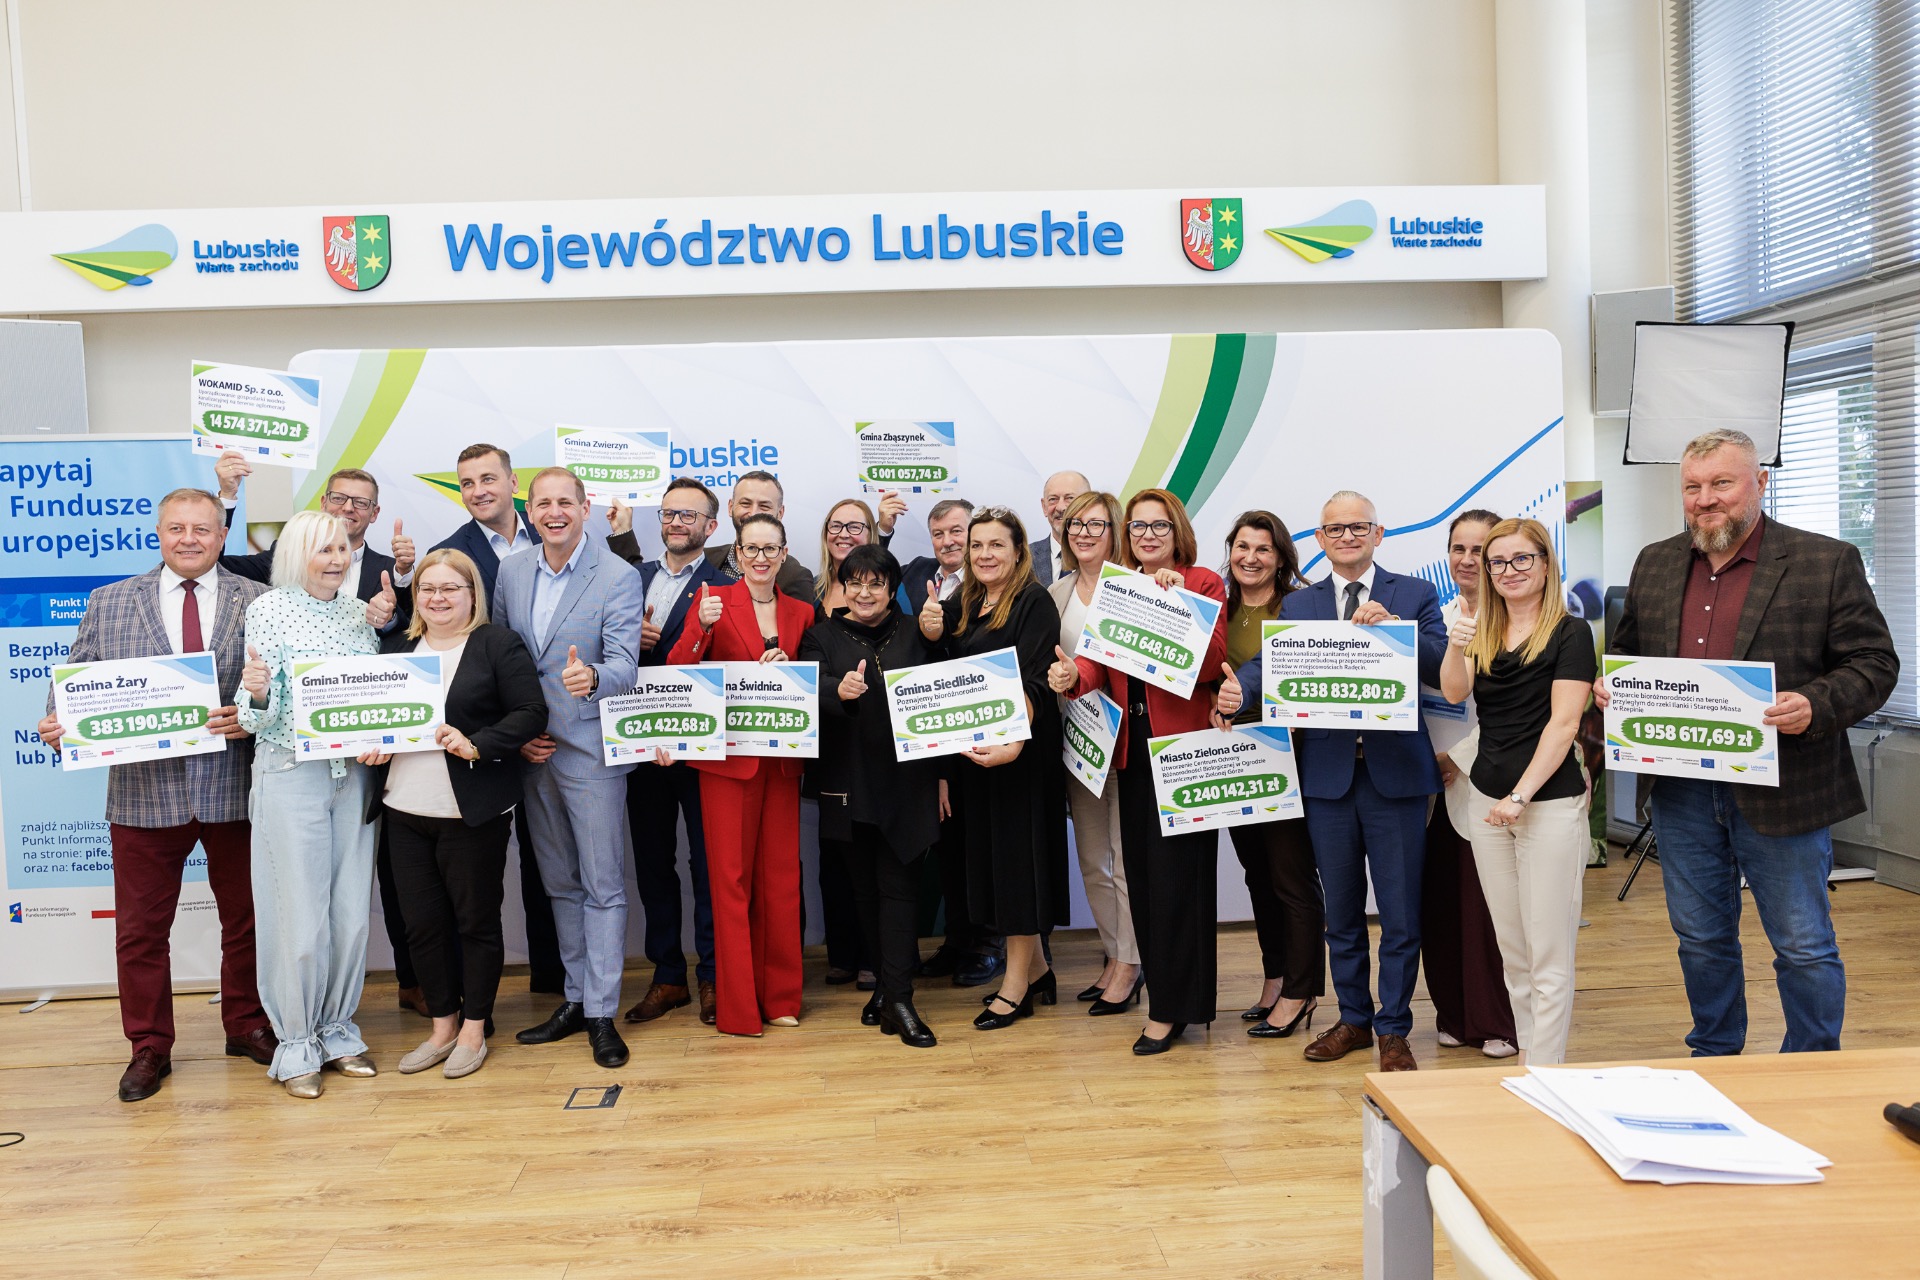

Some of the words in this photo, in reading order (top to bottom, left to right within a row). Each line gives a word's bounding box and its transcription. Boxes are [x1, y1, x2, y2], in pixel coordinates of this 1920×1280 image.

[1390, 216, 1483, 235] Lubuskie
[194, 239, 299, 259] Lubuskie
[443, 218, 850, 284] Województwo
[872, 210, 1124, 261] Lubuskie
[1392, 237, 1427, 248] Warte
[1430, 236, 1482, 247] zachodu
[196, 261, 234, 273] Warte
[240, 259, 298, 272] zachodu
[199, 379, 242, 391] WOKAMID
[245, 385, 258, 394] Sp.
[210, 414, 222, 427] 14
[224, 415, 245, 430] 574
[247, 419, 288, 436] 371,20
[289, 424, 301, 437] zł
[565, 438, 590, 447] Gmina
[593, 441, 628, 450] Zwierzyn
[860, 433, 882, 441] Gmina
[883, 433, 925, 443] Zbąszynek
[670, 439, 778, 468] buskie
[0, 458, 92, 488] apytaj
[573, 466, 586, 476] 10
[589, 468, 608, 479] 159
[610, 469, 645, 481] 785,29
[647, 468, 656, 479] zł
[872, 468, 877, 478] 5
[879, 468, 895, 478] 001
[898, 468, 931, 480] 057,74
[933, 468, 941, 479] zł
[10, 493, 152, 517] Fundusze
[2, 528, 161, 558] uropejskie
[50, 598, 81, 608] Punkt
[1103, 580, 1127, 595] Gmina
[1128, 589, 1154, 605] Krosno
[1155, 599, 1192, 619] Odrzańskie
[50, 609, 88, 619] Fundus
[9, 642, 70, 662] Bezpła
[1108, 624, 1116, 638] 1
[1116, 628, 1139, 646] 581
[1139, 636, 1177, 661] 648,16
[1175, 652, 1188, 666] zł
[65, 680, 113, 693] Gmina
[116, 675, 148, 688] Żary
[302, 675, 339, 687] Gmina
[341, 671, 408, 684] Trzebiechów
[740, 678, 782, 691] Świdnica
[895, 683, 932, 697] Gmina
[934, 674, 985, 691] Siedlisko
[1612, 677, 1651, 690] Gmina
[1655, 679, 1699, 694] Rzepin
[646, 683, 692, 694] Pszczew
[1289, 682, 1297, 697] 2
[1301, 682, 1328, 698] 538
[1331, 683, 1381, 701] 832,80
[1383, 684, 1397, 700] zł
[1613, 691, 1640, 700] Wsparcie
[1640, 693, 1695, 703] bioróżnorodności
[896, 695, 933, 706] Poznajemy
[905, 704, 927, 712] krainie
[1079, 697, 1099, 718] ozdnica
[1613, 699, 1645, 708] przyległym
[1693, 703, 1718, 712] Starego
[90, 718, 124, 737] 383
[126, 711, 183, 731] 190,54
[185, 709, 199, 725] zł
[318, 713, 326, 728] 1
[329, 710, 358, 728] 856
[360, 707, 411, 725] 032,29
[413, 707, 426, 721] zł
[728, 712, 752, 726] 672
[755, 712, 794, 729] 271,35
[795, 713, 804, 727] zł
[916, 715, 943, 731] 523
[945, 705, 993, 727] 890,19
[995, 702, 1006, 716] zł
[624, 718, 652, 735] 624
[655, 717, 698, 734] 422,68
[699, 718, 710, 732] zł
[1633, 722, 1641, 738] 1
[1645, 724, 1676, 741] 958
[1679, 727, 1735, 747] 617,69
[1737, 730, 1753, 747] zł
[16, 750, 46, 765] lub
[1160, 752, 1193, 764] Miasto
[1194, 746, 1230, 759] Zielona
[1232, 742, 1257, 753] Góra
[1182, 790, 1191, 804] 2
[1193, 785, 1220, 802] 240
[1221, 779, 1264, 798] 142,31
[1266, 777, 1279, 792] zł
[21, 821, 57, 833] znajdź
[22, 836, 55, 846] Punkt
[58, 833, 113, 845] Informacy
[23, 851, 38, 859] na
[41, 848, 82, 859] stronie:
[24, 864, 48, 873] oraz
[51, 863, 68, 872] na:
